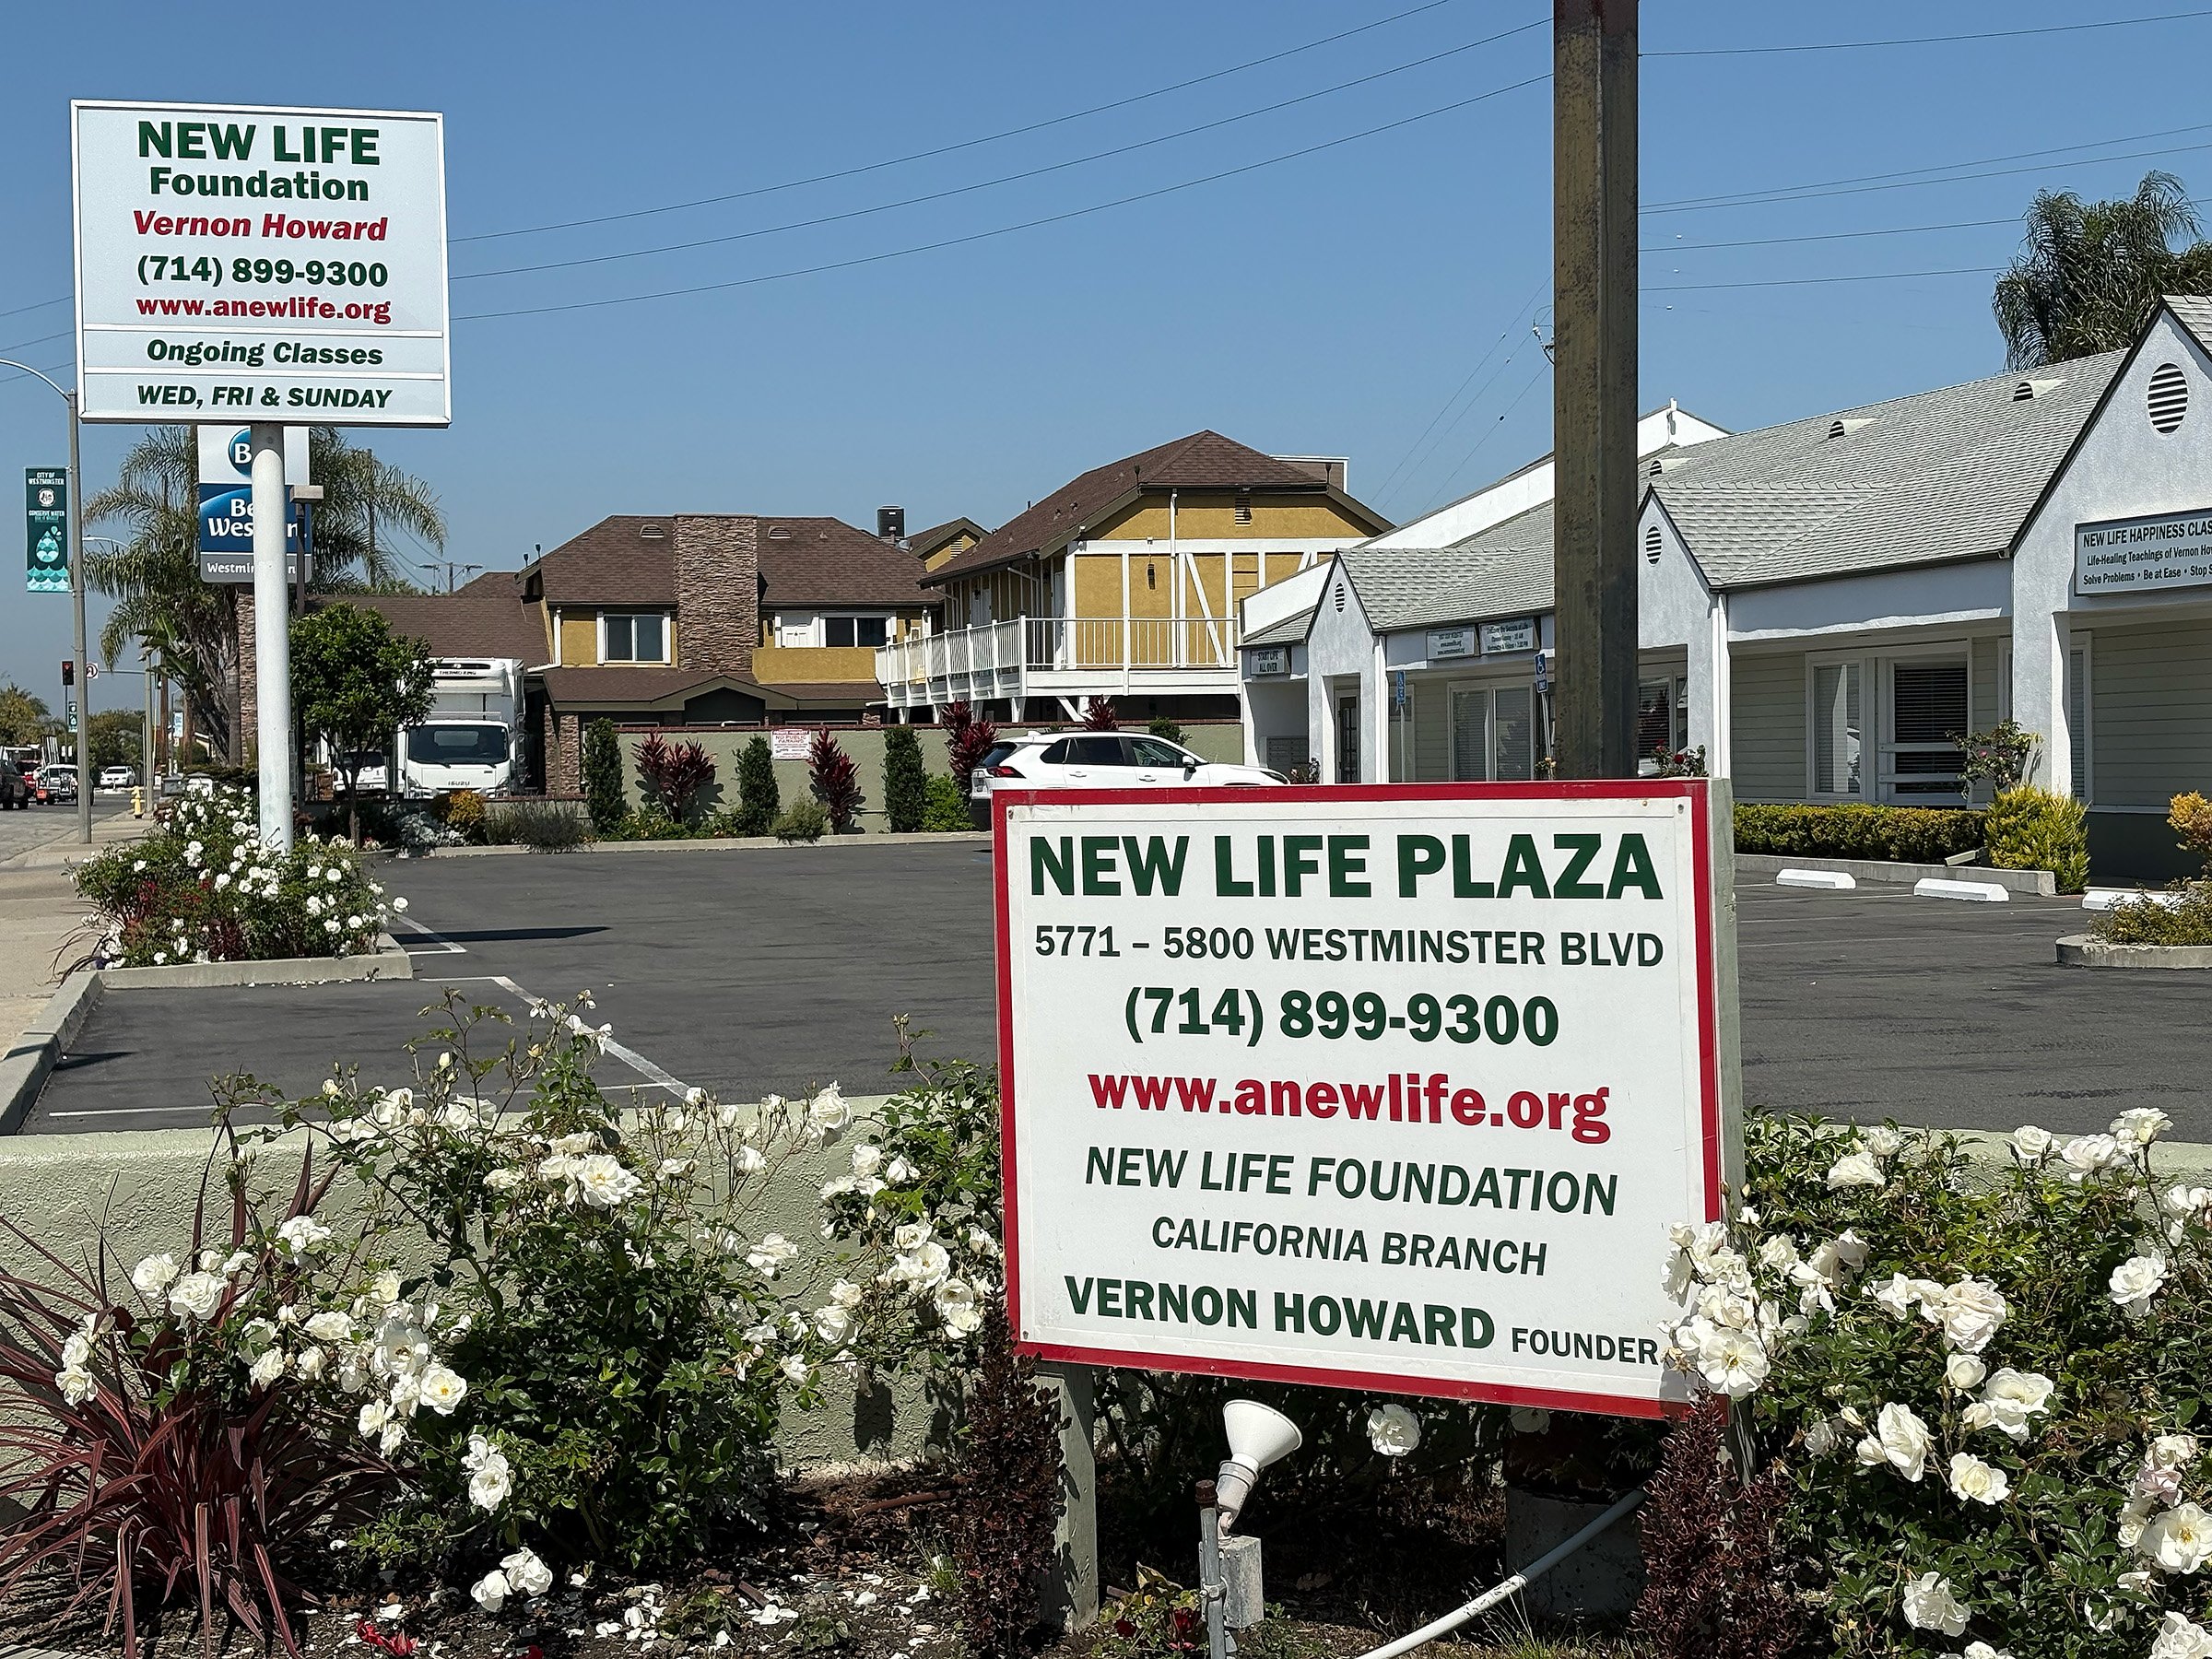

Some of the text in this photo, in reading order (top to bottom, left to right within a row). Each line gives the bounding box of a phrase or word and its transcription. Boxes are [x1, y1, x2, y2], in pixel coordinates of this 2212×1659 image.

[138, 121, 380, 165] NEW LIFE
[150, 167, 369, 201] Foundation
[134, 210, 388, 241] Vernon Howard
[137, 255, 388, 287] (714) 899-9300
[136, 296, 392, 324] www.anewlife.org
[147, 339, 383, 367] Ongoing Classes
[137, 385, 393, 409] WED, FRI & SUNDAY
[2083, 532, 2105, 547] NEW
[2107, 529, 2127, 546] LIFE
[2129, 523, 2185, 543] HAPPINESS
[2087, 553, 2127, 566] Life-Healing
[2128, 548, 2163, 561] Teachings
[2164, 547, 2173, 559] of
[2172, 546, 2199, 558] Vernon
[2083, 574, 2101, 585] Solve
[2103, 571, 2136, 583] Problems
[2143, 569, 2153, 580] Be
[2154, 569, 2162, 579] at
[2163, 567, 2182, 579] Ease
[2190, 565, 2207, 577] Stop
[1030, 833, 1664, 900] NEW LIFE PLAZA
[1035, 925, 1121, 957] 5771
[1163, 926, 1254, 959] 5800
[1265, 927, 1546, 964] WESTMINSTER
[1560, 932, 1664, 967] BLVD
[1125, 986, 1559, 1047] (714) 899-9300
[1087, 1073, 1611, 1144] www.anewlife.org
[1086, 1146, 1618, 1216] NEW LIFE FOUNDATION
[1152, 1216, 1547, 1276] CALIFORNIA BRANCH
[1064, 1275, 1658, 1366] VERNON HOWARD FOUNDER
